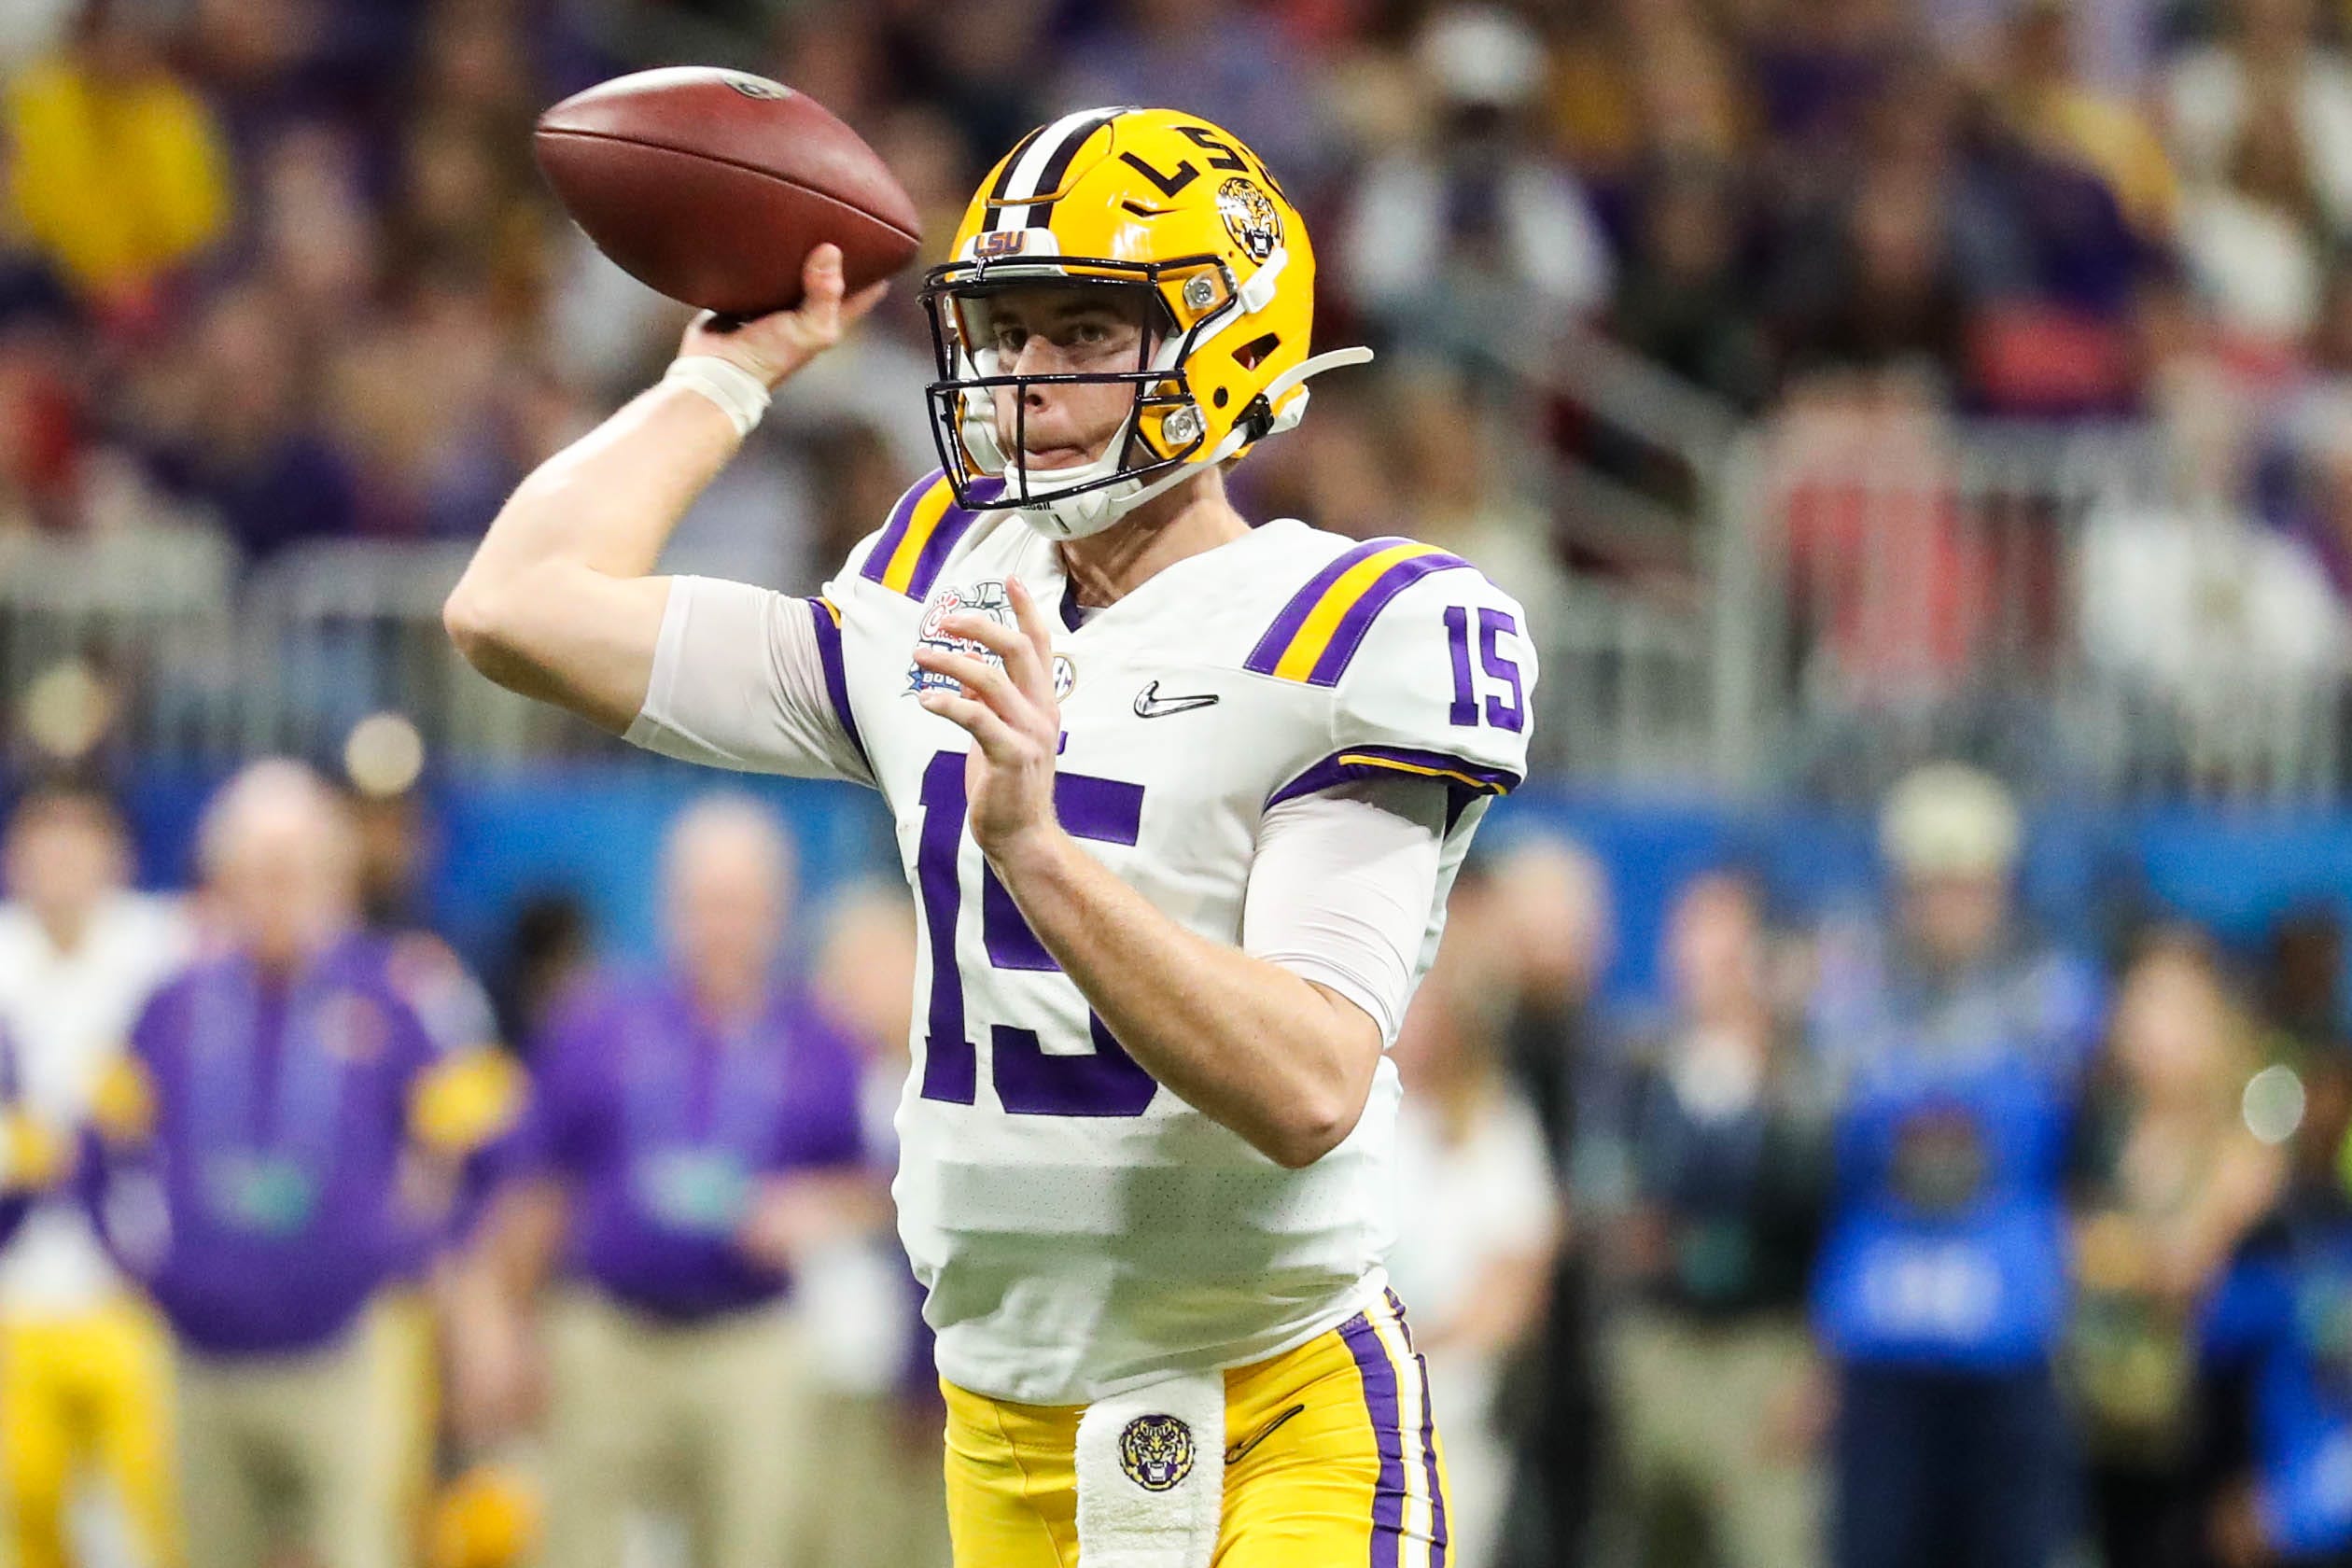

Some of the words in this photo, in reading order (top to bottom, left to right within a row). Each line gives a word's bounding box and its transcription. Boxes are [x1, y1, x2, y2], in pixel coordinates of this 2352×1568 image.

[973, 230, 1028, 258] LSU
[922, 673, 962, 687] BOW
[1443, 605, 1524, 735] 15
[918, 749, 1159, 1118] 15
